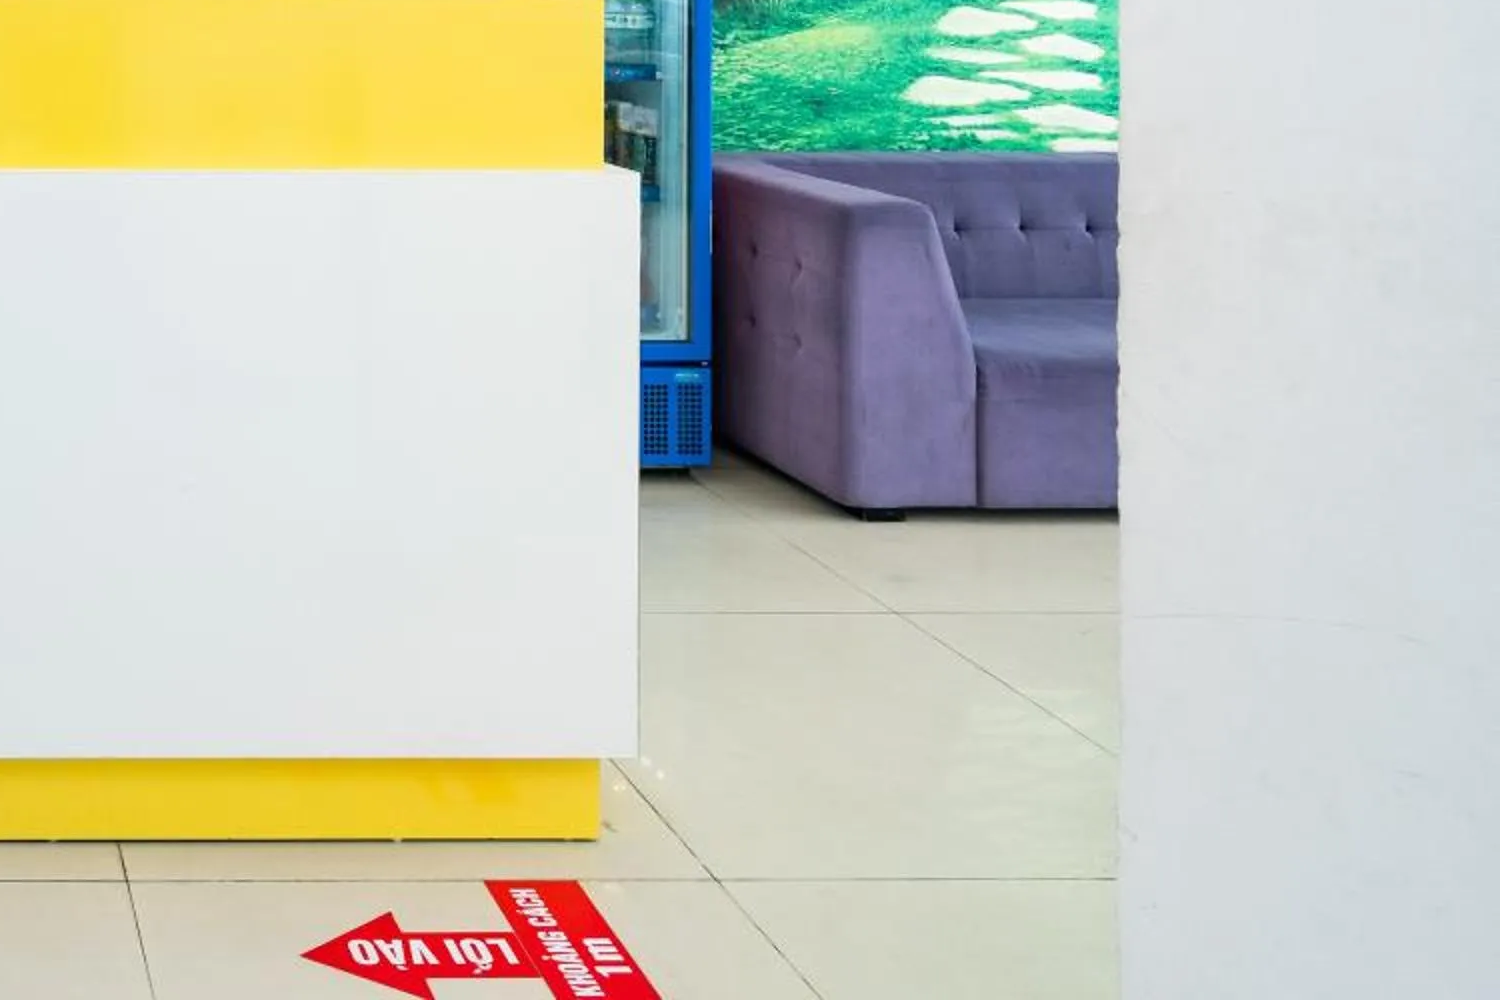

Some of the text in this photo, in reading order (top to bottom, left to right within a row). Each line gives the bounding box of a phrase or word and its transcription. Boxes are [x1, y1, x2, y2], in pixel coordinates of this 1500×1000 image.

[508, 888, 558, 928] CÁCH
[347, 937, 520, 975] LỐI VÀO
